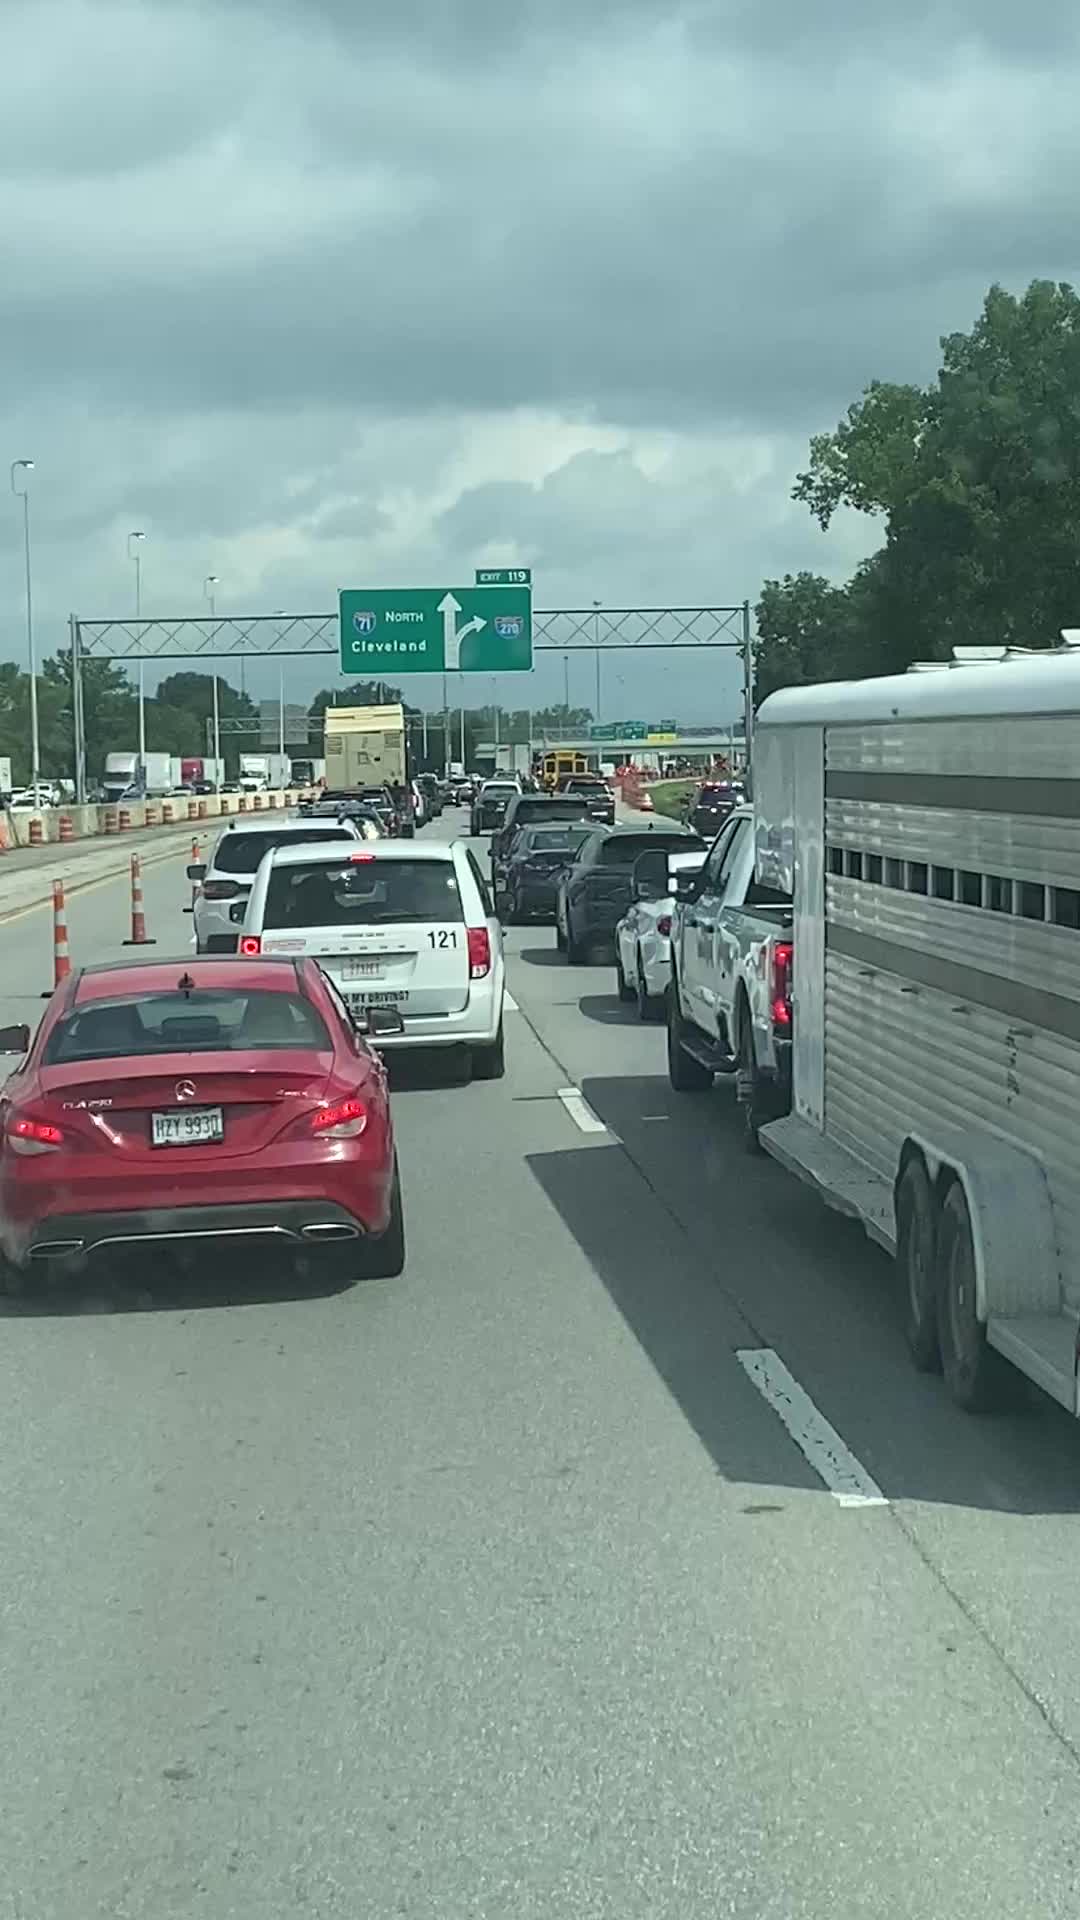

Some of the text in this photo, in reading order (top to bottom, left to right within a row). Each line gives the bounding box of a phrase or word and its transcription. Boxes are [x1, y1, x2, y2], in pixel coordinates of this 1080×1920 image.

[480, 571, 527, 582] EXIT 119
[358, 611, 424, 630] 71 NORTH
[500, 623, 519, 634] 270
[351, 640, 427, 652] Cleveland
[427, 930, 458, 949] 121
[156, 1118, 181, 1138] HZY
